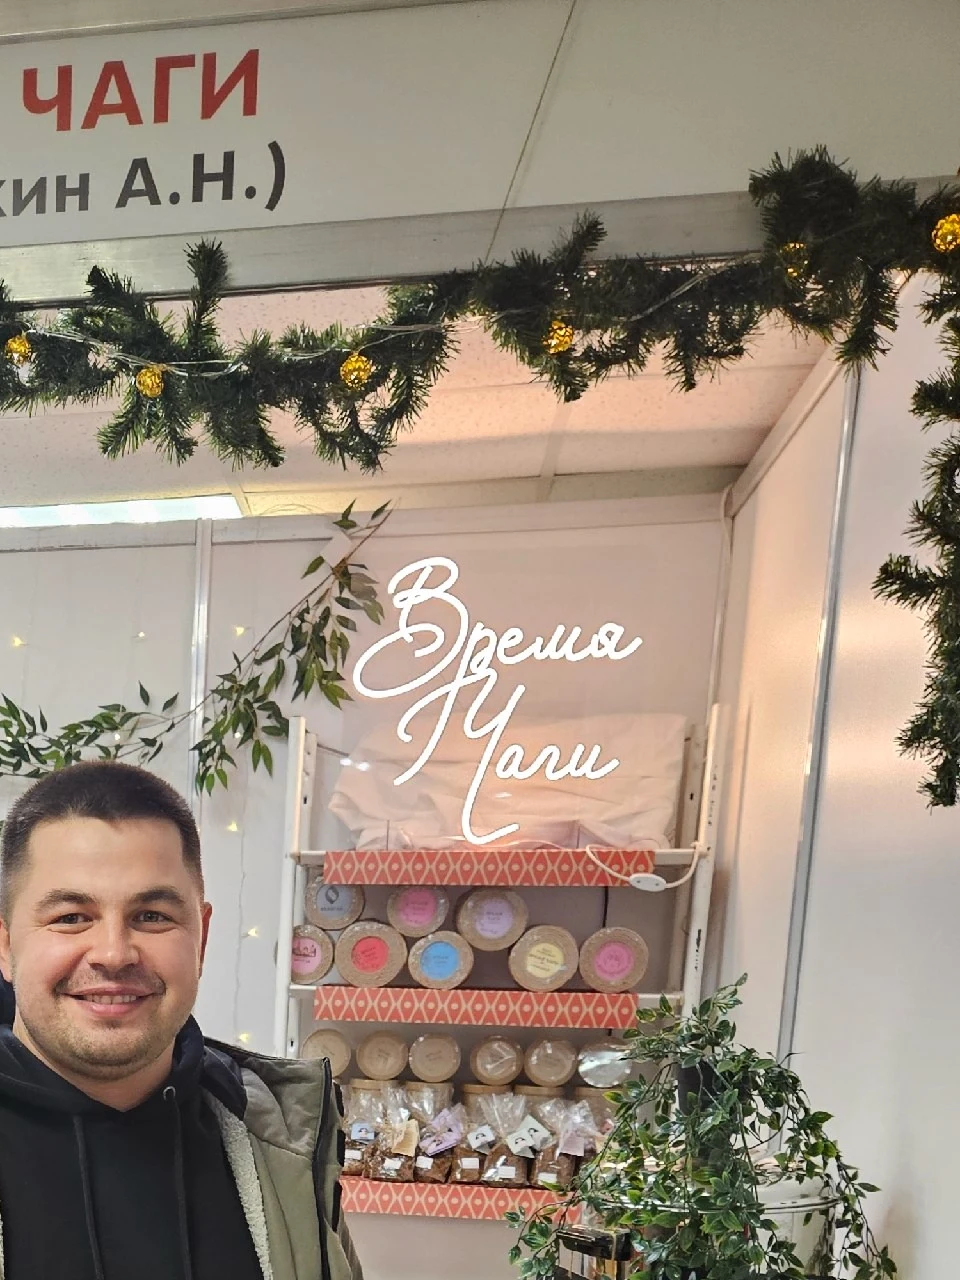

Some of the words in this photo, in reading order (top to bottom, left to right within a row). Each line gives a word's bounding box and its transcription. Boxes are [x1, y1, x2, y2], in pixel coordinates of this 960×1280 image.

[22, 48, 260, 132] ЧАГИ
[115, 140, 286, 212] А.Н.)
[352, 556, 643, 787] Время
[397, 667, 620, 845] Чаги
